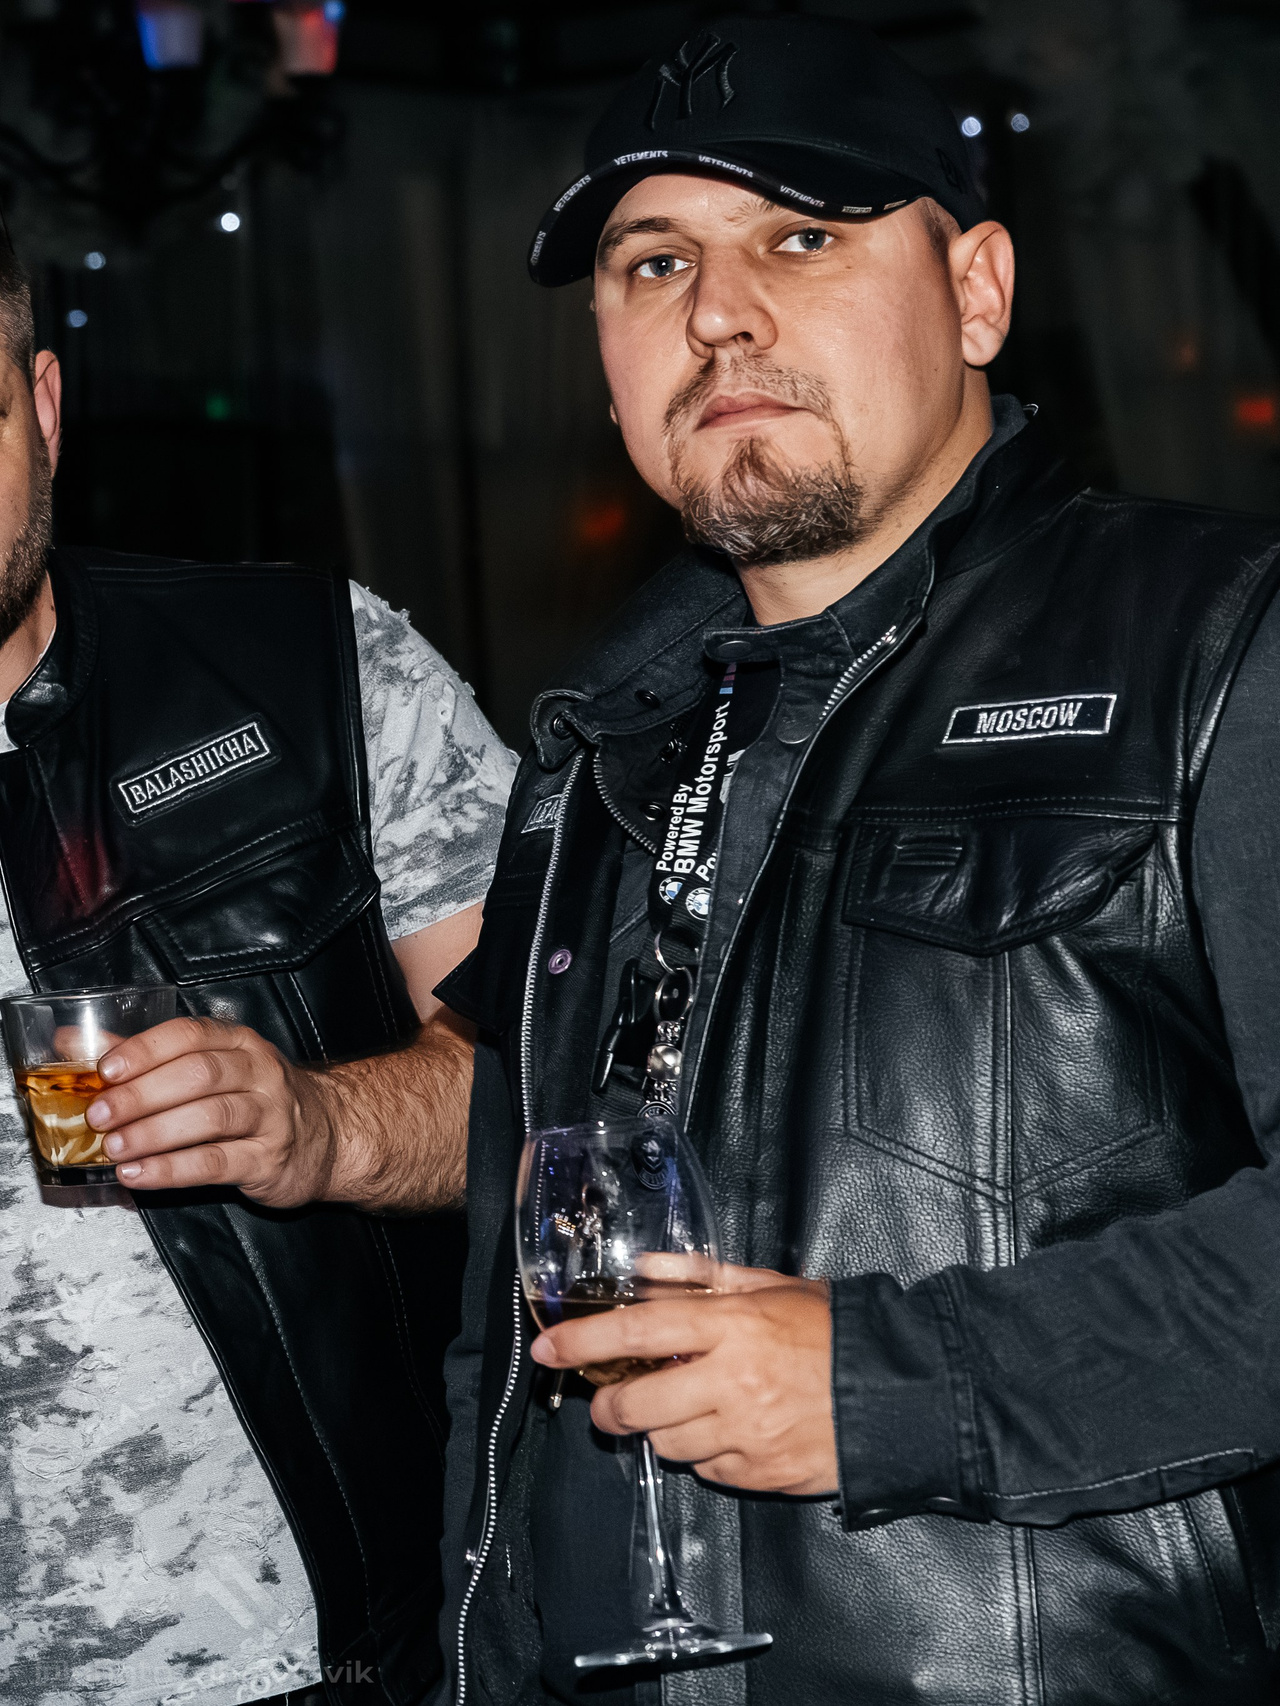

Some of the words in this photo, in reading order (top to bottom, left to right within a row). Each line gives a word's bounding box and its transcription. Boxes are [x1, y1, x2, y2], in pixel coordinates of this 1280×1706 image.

[613, 150, 669, 165] VETEMENTS
[698, 155, 754, 178] VETEMENTS
[553, 174, 592, 212] VETEMENTS
[973, 702, 1083, 734] MOSCOW
[129, 733, 260, 805] BALASHIKHA
[687, 701, 730, 813] Motorsport
[655, 806, 683, 872] Powered
[673, 783, 693, 804] By
[674, 820, 704, 875] BMW
